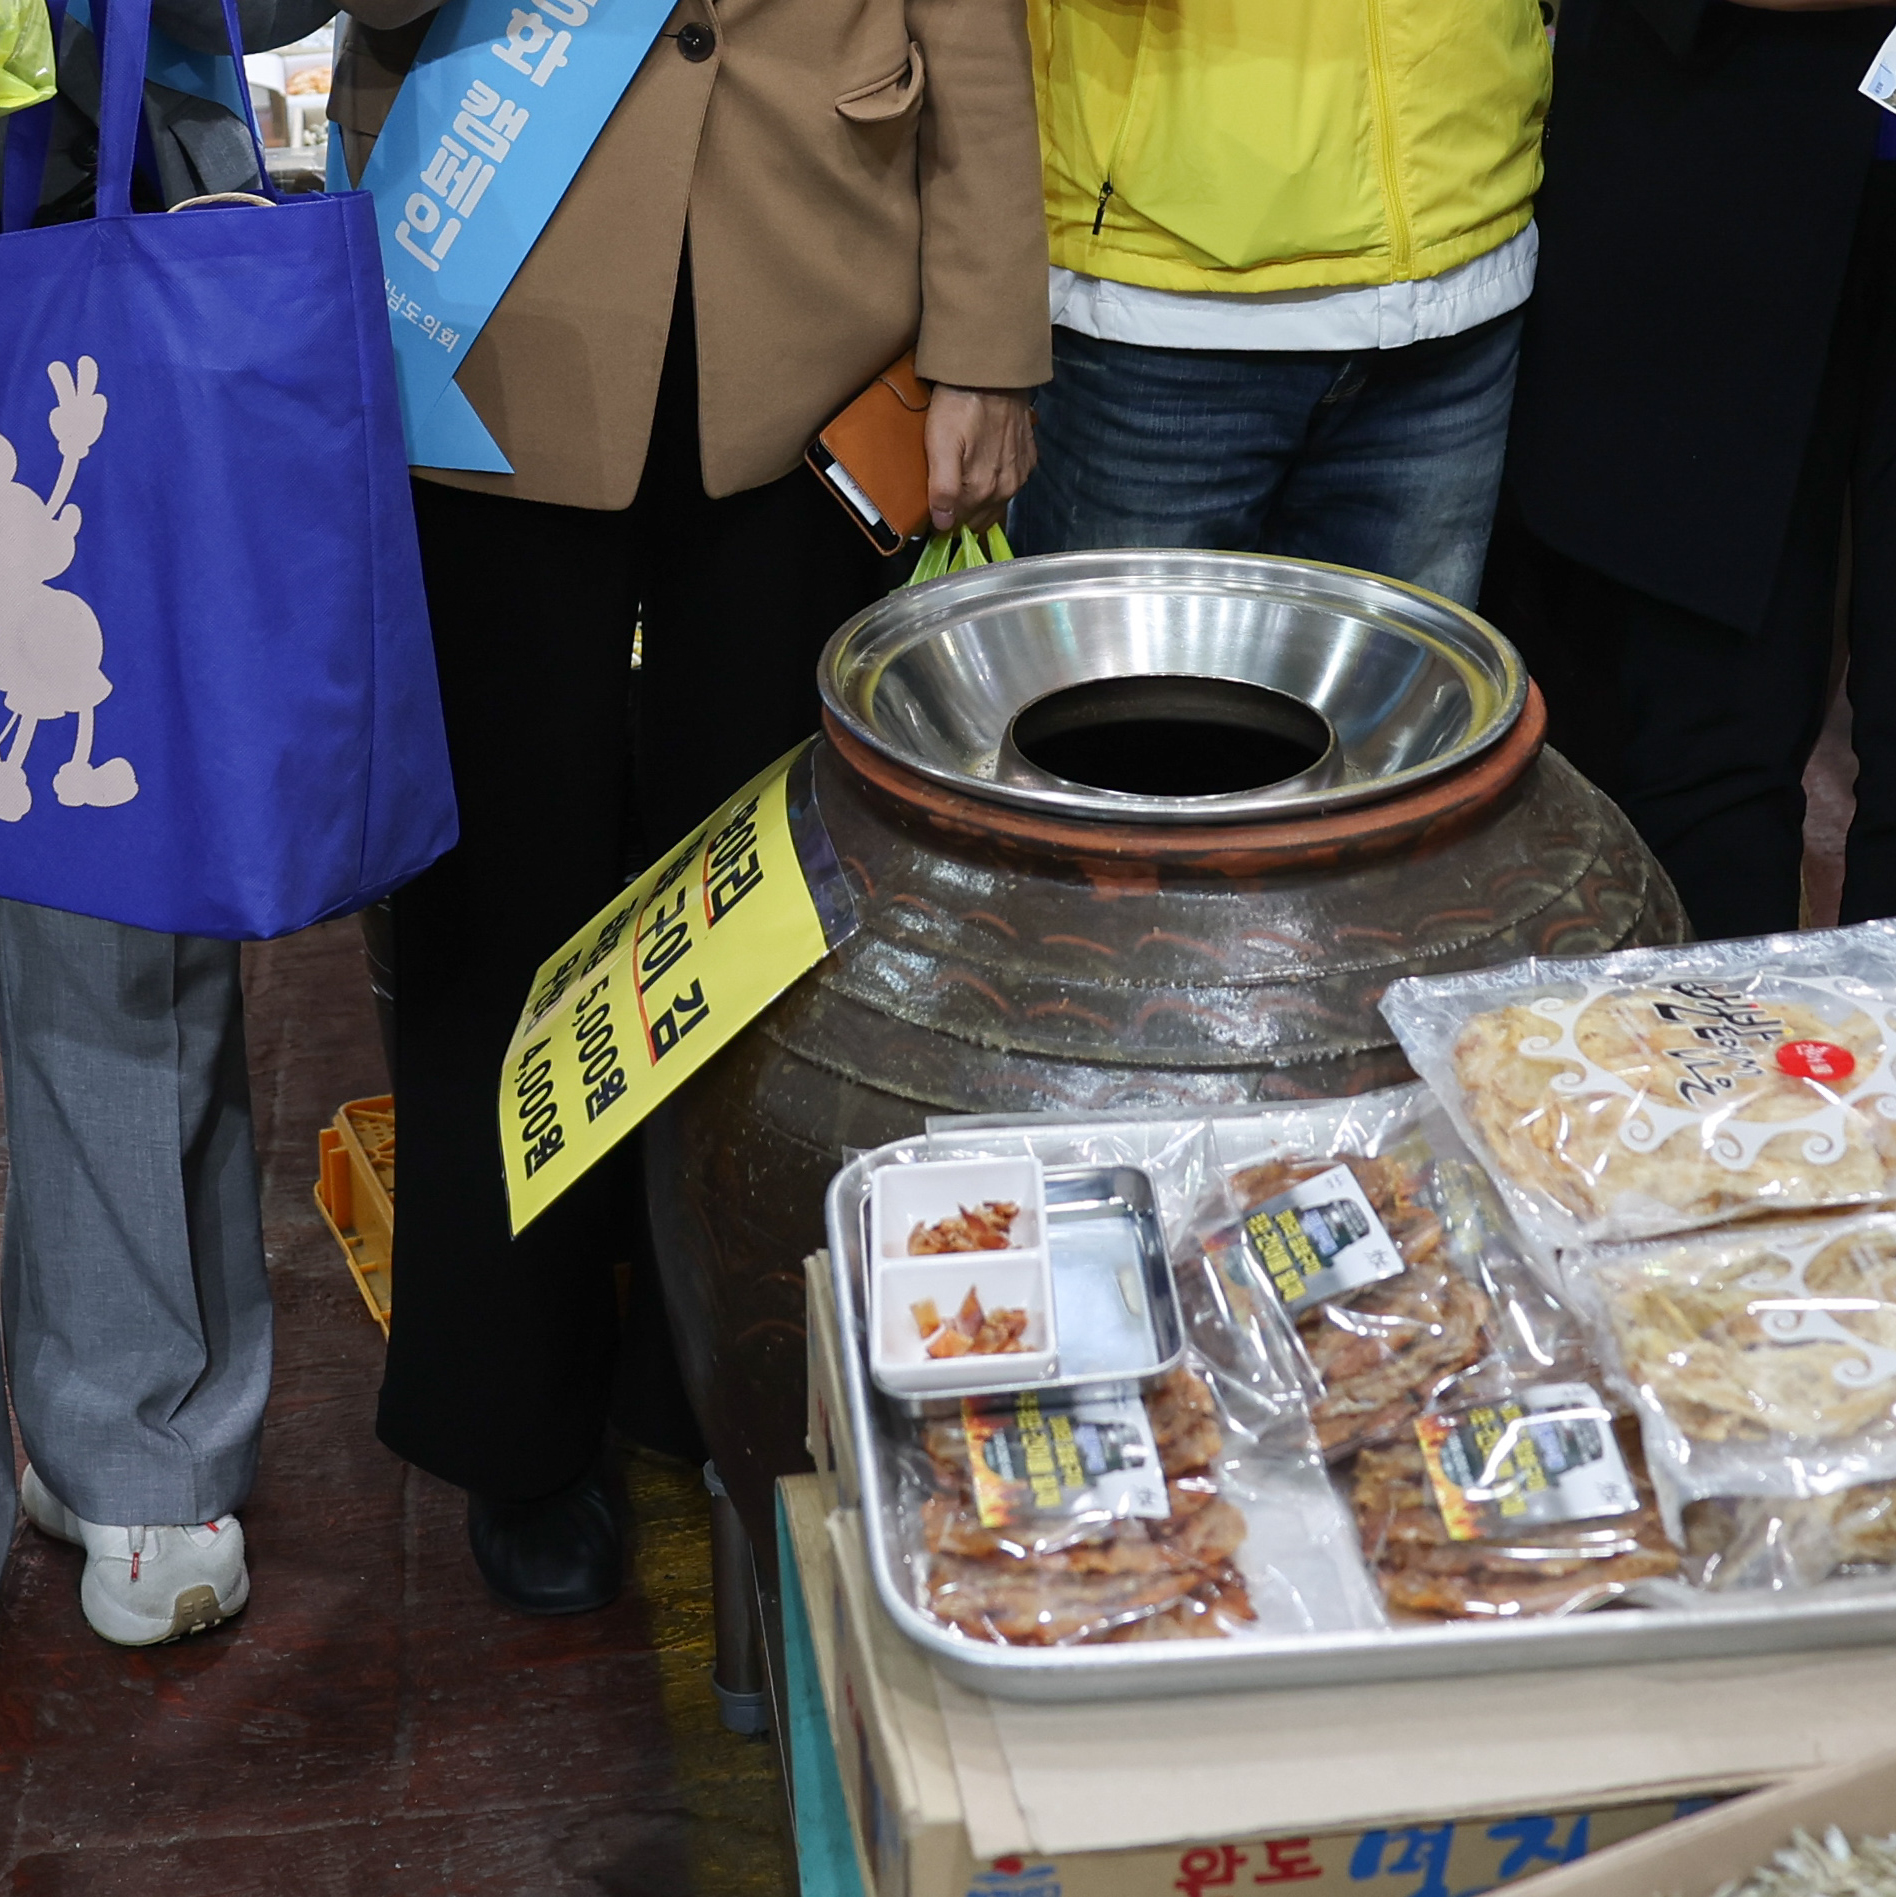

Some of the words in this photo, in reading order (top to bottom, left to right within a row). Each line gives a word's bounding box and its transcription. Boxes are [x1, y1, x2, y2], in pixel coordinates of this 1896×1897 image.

[395, 82, 529, 272] 캠페인
[710, 792, 764, 928] 항아리
[637, 885, 692, 996] 구이
[575, 977, 628, 1124] 5,000원
[652, 977, 711, 1062] 김
[513, 1036, 566, 1181] 4,000원
[1176, 1839, 1322, 1894] 완도
